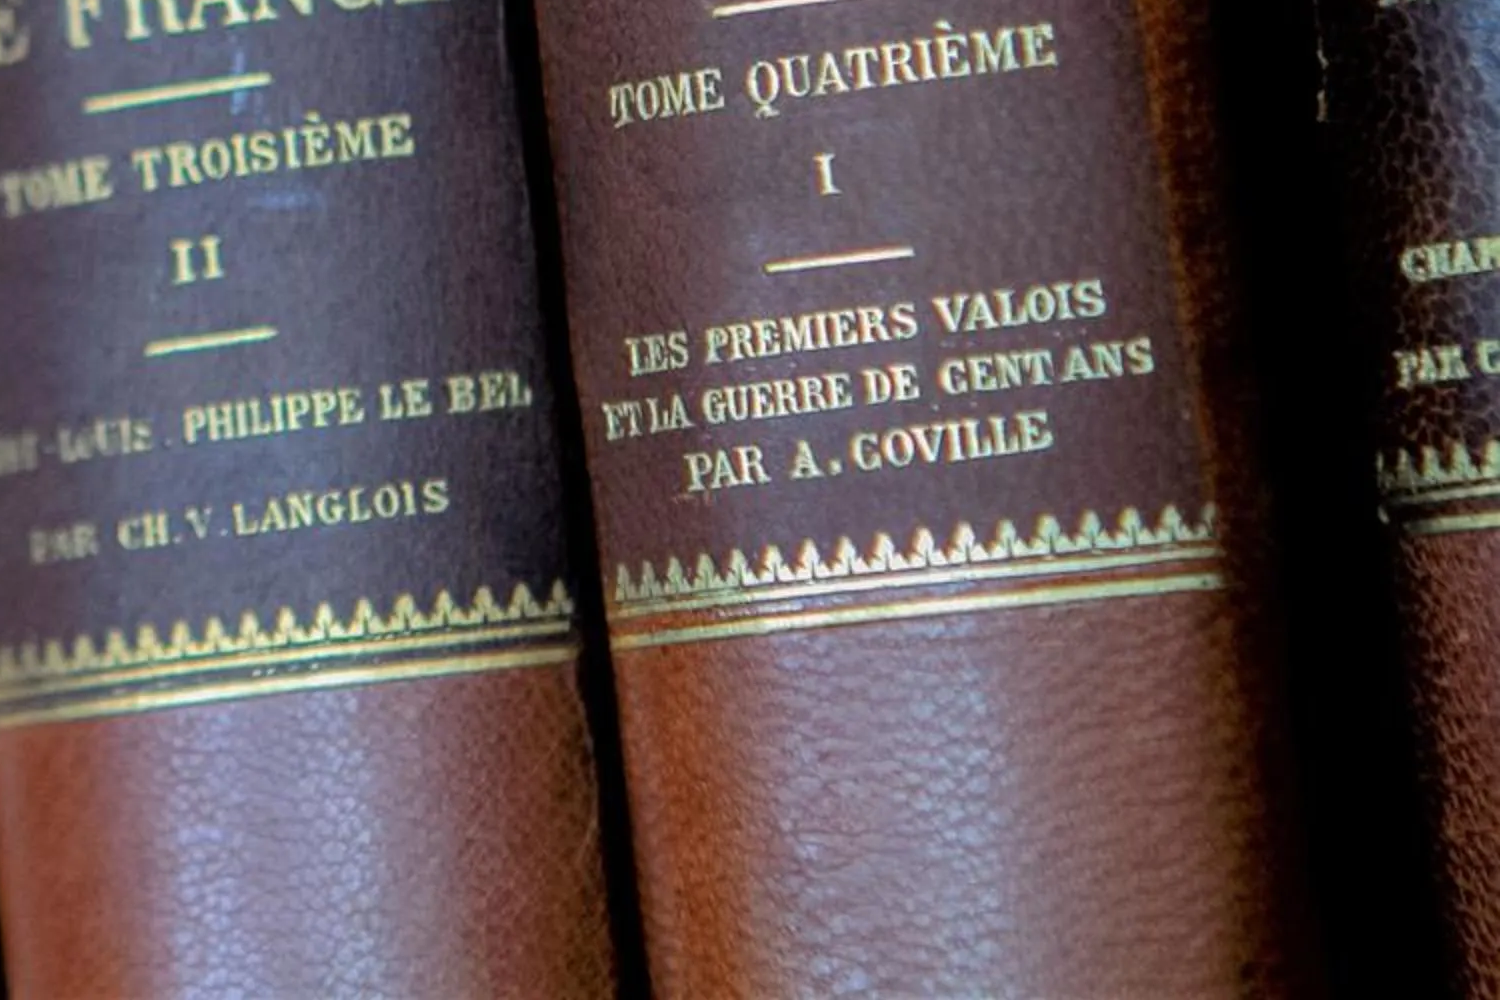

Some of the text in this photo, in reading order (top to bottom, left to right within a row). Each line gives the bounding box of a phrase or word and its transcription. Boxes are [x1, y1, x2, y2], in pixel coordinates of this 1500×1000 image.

[610, 20, 1058, 128] TOME QUATRIÈME
[132, 112, 415, 192] TROISIÈME
[814, 153, 841, 195] I
[170, 236, 225, 285] II
[625, 279, 1106, 377] LES PREMIERS VALOIS
[183, 388, 365, 445] PHILIPPE
[379, 379, 432, 419] LE
[447, 371, 532, 414] BEL
[702, 372, 853, 425] GUERRE
[864, 364, 920, 405] DE
[684, 445, 770, 492] PAR
